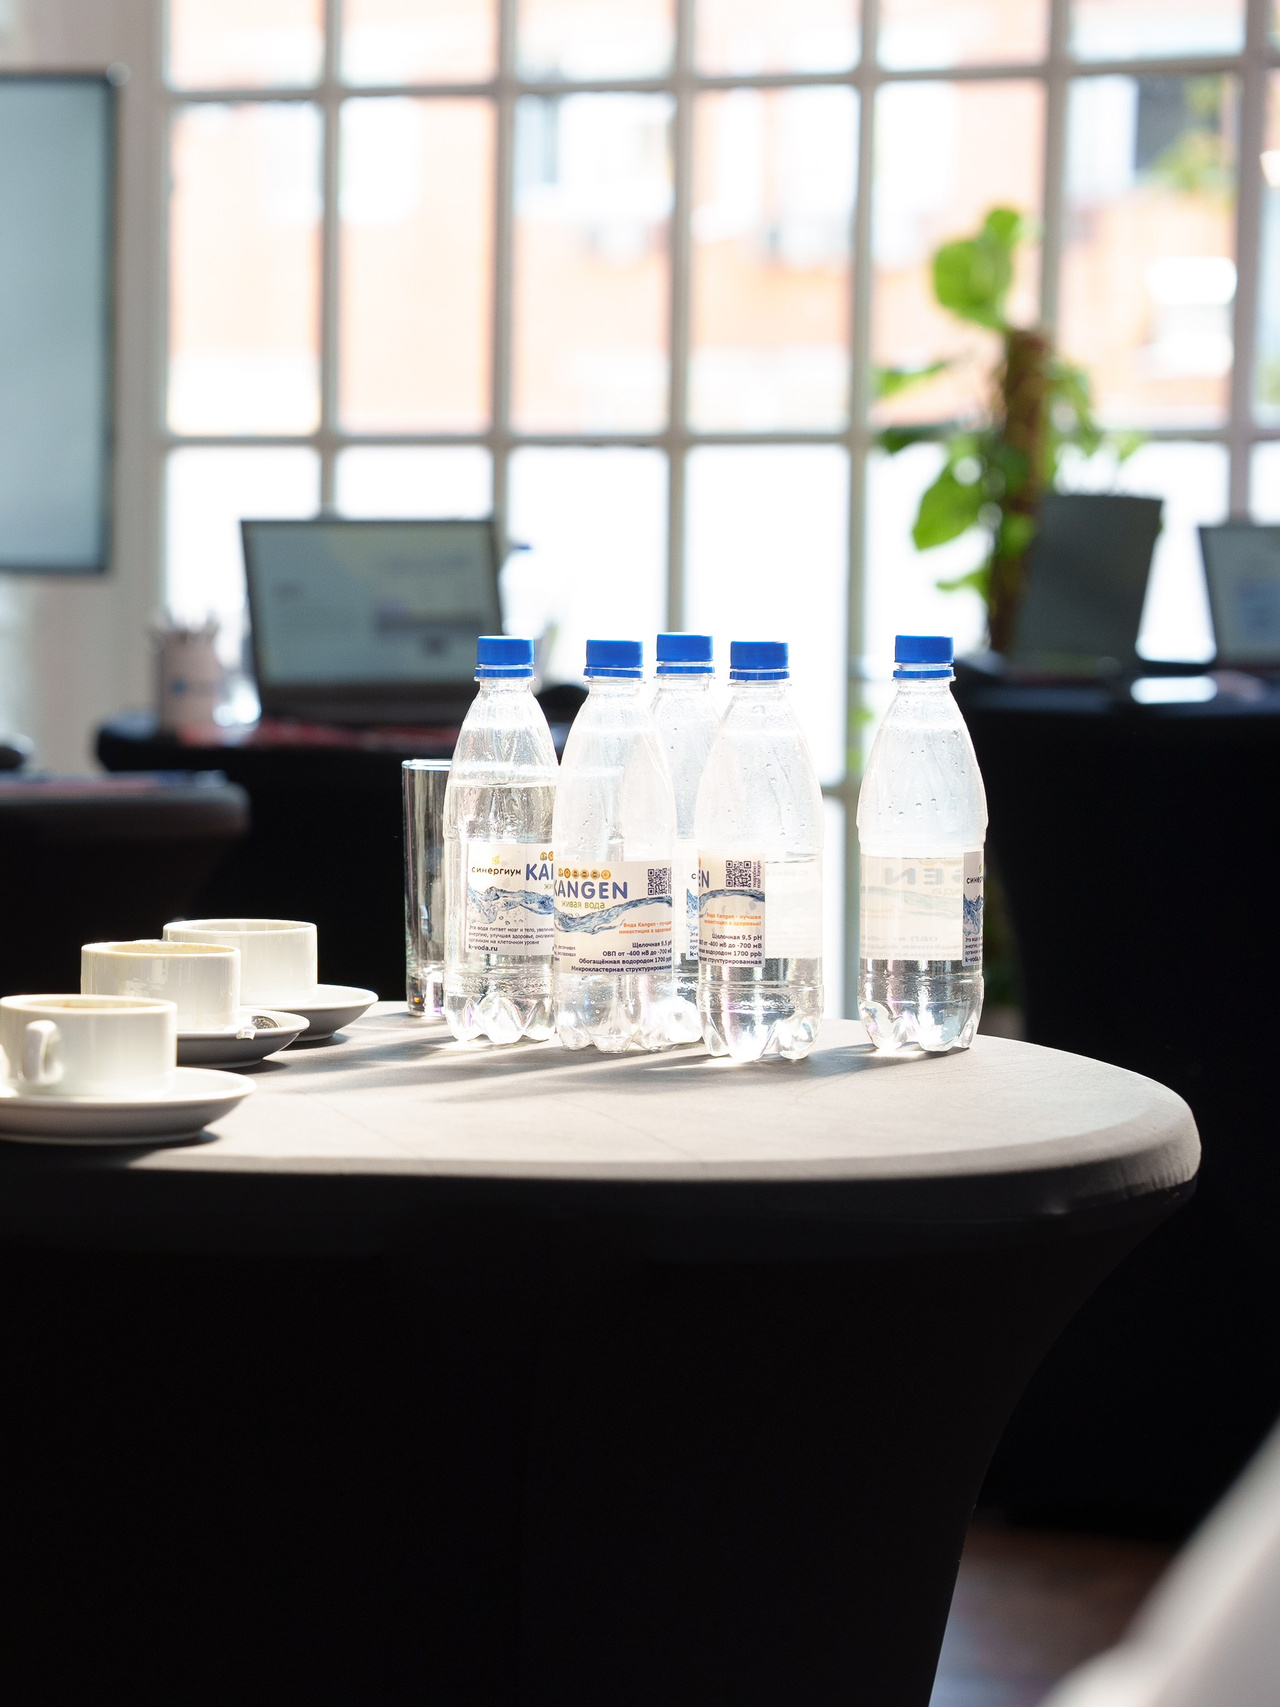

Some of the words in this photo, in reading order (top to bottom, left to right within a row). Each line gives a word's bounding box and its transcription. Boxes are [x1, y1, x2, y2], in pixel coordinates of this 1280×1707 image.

[472, 866, 521, 876] синергиум
[585, 901, 606, 910] вода
[571, 965, 624, 973] Микрокластерная
